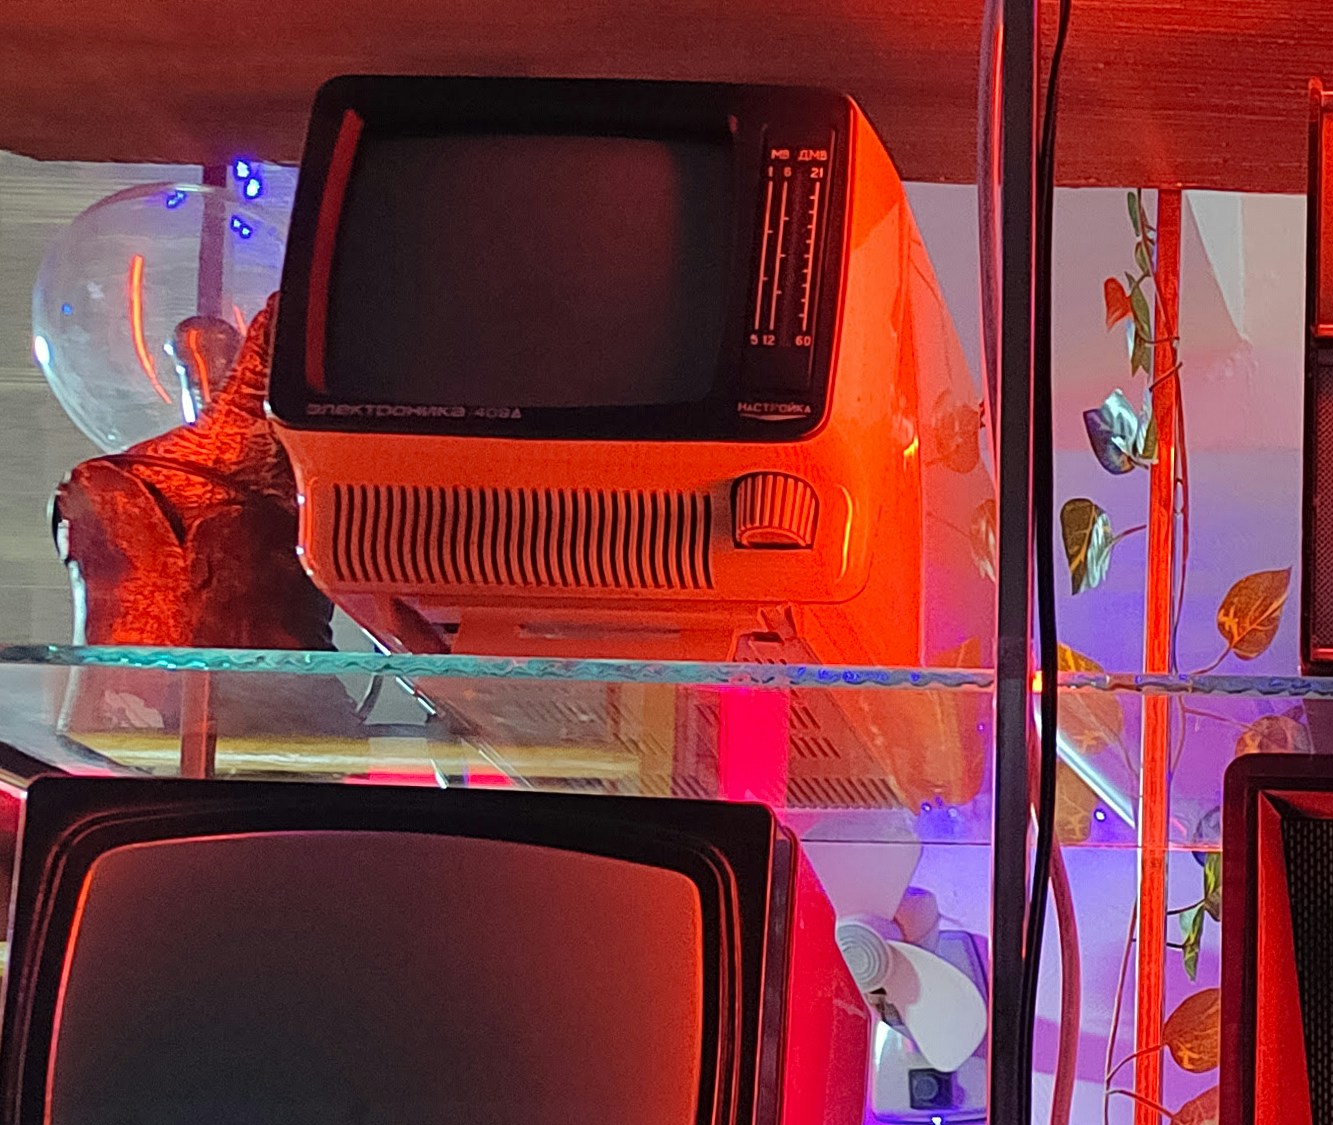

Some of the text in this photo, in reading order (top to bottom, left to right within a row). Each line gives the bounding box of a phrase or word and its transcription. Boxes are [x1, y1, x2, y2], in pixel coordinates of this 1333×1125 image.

[810, 167, 824, 178] 21
[795, 336, 811, 346] 60
[737, 402, 812, 413] НАСТРОЙКА
